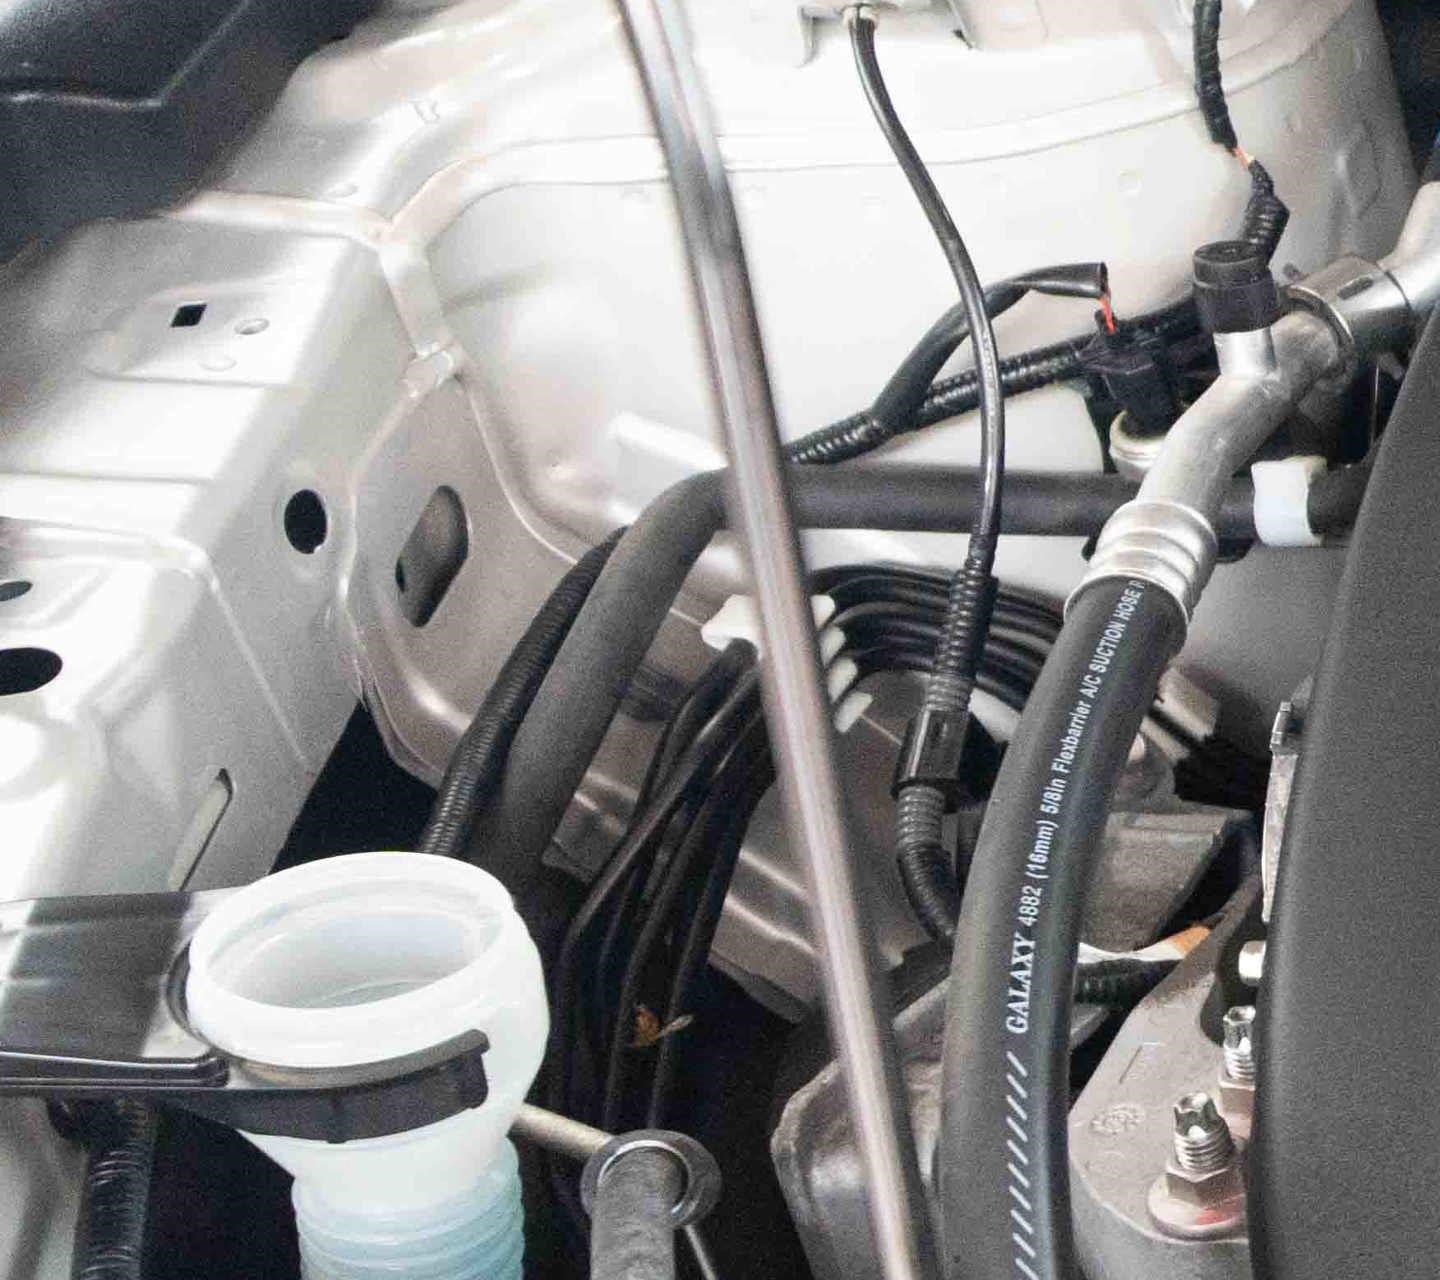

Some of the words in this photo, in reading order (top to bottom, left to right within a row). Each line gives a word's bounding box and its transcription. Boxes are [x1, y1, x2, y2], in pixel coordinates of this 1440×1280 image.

[1113, 587, 1143, 621] HOSE
[1089, 619, 1126, 673] SUCTION
[1080, 674, 1102, 699] A/C
[1052, 701, 1093, 773] Flexbarrier
[1040, 777, 1067, 815] 5/8in
[1025, 820, 1060, 880] (16mm)
[1017, 885, 1043, 927] 4882
[1006, 931, 1036, 1034] GALAXY
